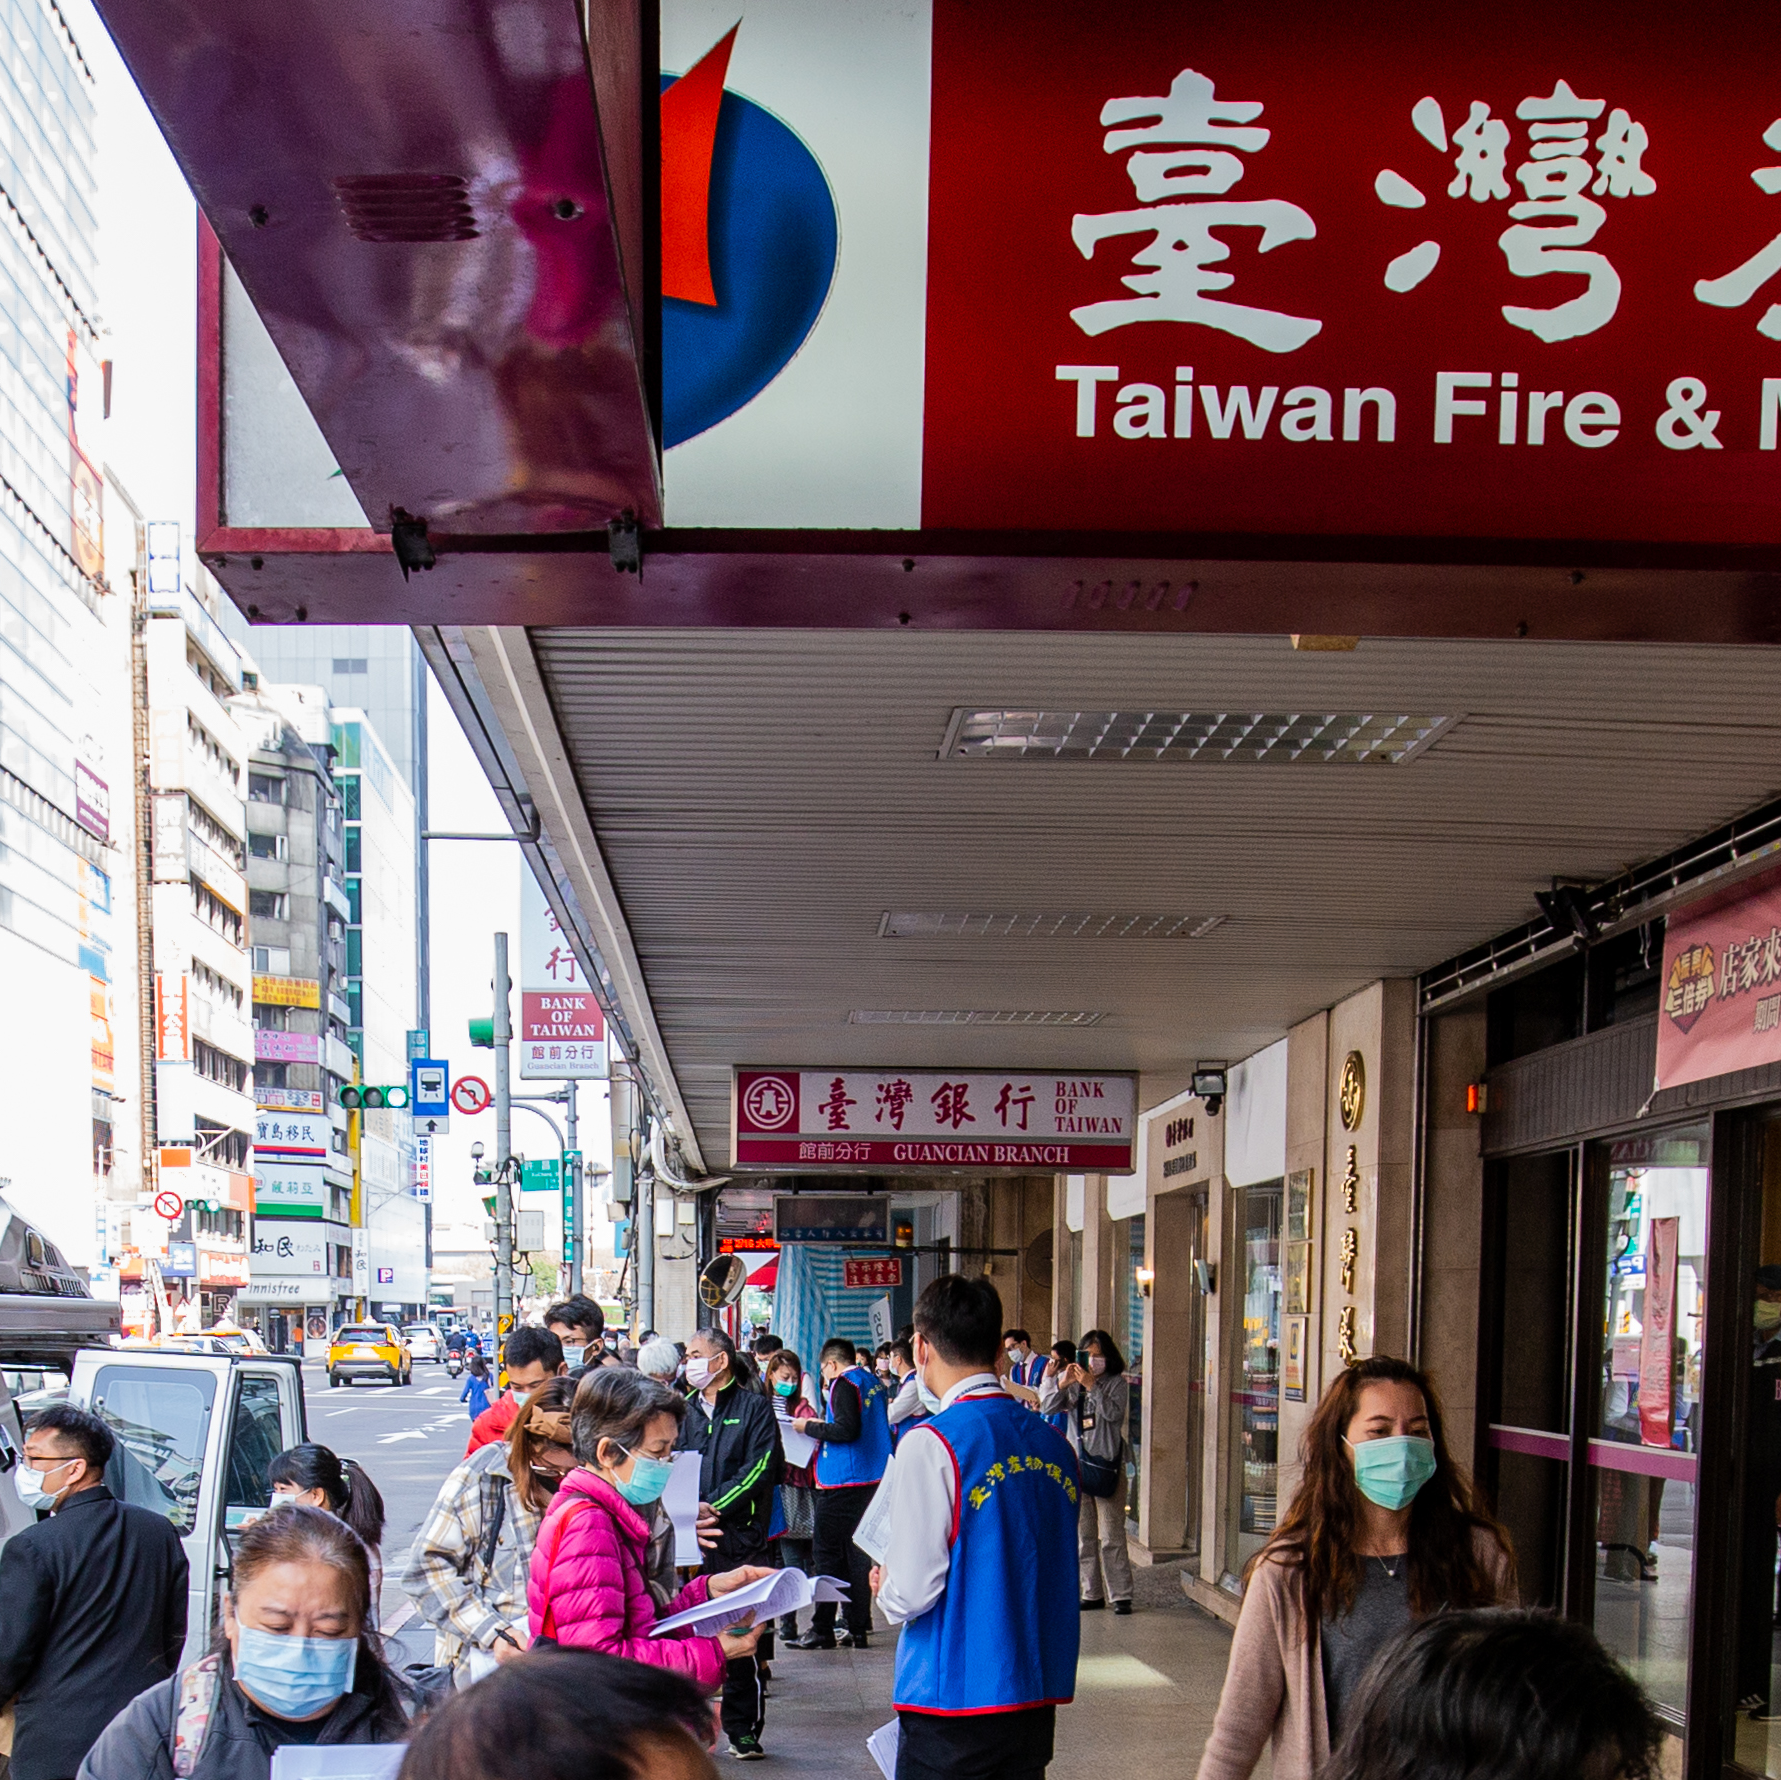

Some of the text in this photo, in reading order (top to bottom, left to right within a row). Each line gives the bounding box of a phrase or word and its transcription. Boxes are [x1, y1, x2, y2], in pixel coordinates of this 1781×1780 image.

[1055, 364, 1398, 445] Taiwan
[1433, 370, 1621, 449] Fire
[1654, 375, 1725, 452] &
[539, 997, 587, 1011] BANK
[550, 1010, 573, 1023] OF
[529, 1024, 596, 1037] TAIWAN
[531, 1045, 595, 1060] 館前分行
[569, 1061, 600, 1071] Branch
[1054, 1081, 1105, 1099] BANK
[817, 1077, 1036, 1132] 臺灣銀行
[1054, 1100, 1078, 1115] OF
[1054, 1116, 1123, 1135] TAIWAN
[797, 1140, 872, 1160] 館前分行
[893, 1144, 1070, 1165] GUANCIAN BRANCH
[248, 1281, 300, 1295] innisfree
[968, 1455, 1076, 1510] 臺灣產物保險
